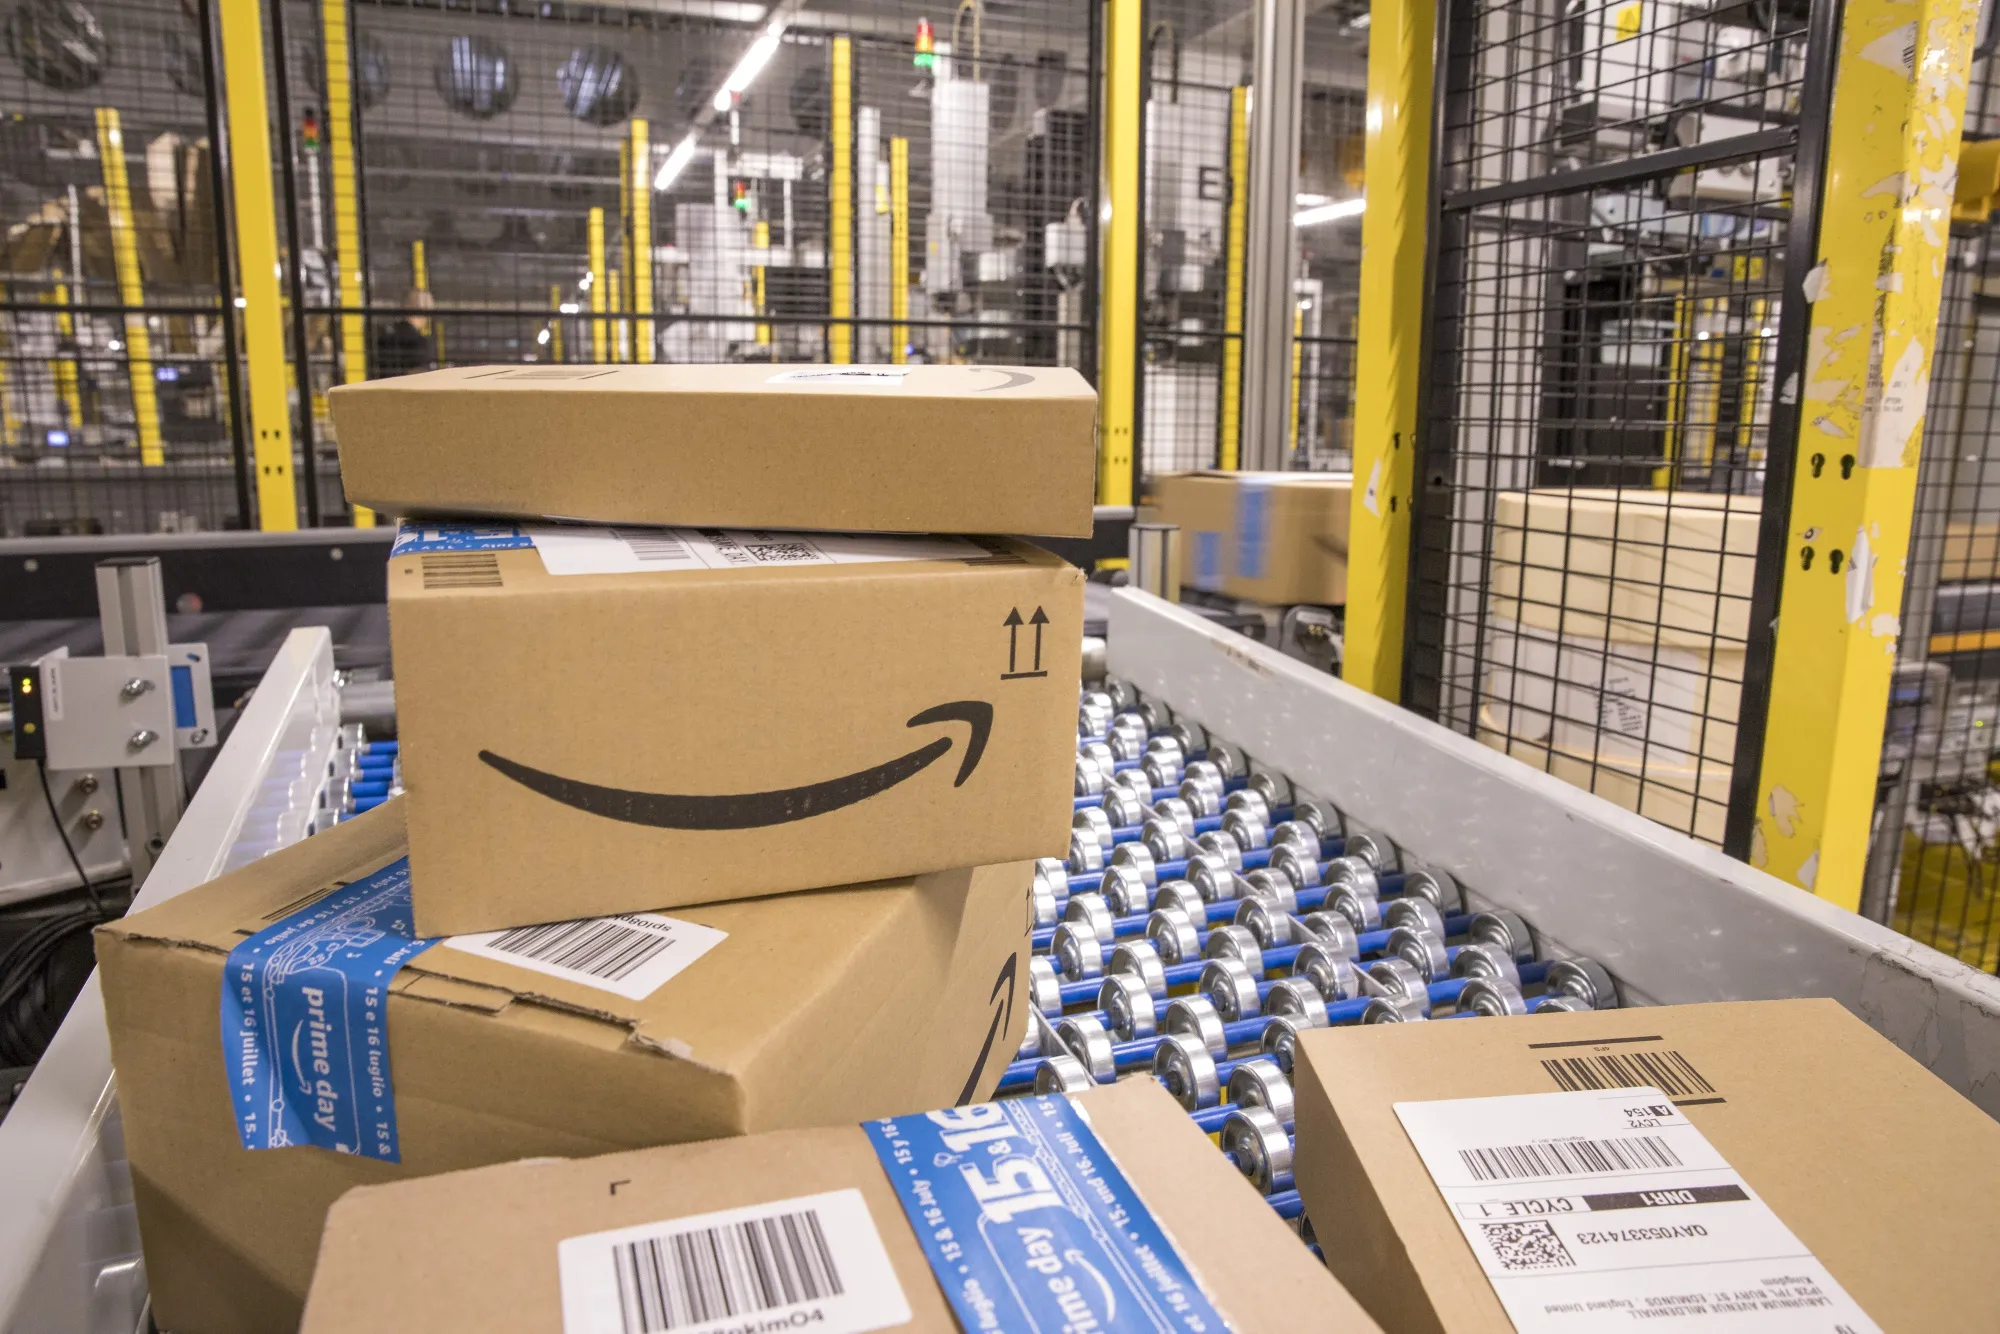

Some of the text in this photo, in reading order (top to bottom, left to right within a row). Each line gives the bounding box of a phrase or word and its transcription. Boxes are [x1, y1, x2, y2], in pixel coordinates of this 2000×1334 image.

[240, 962, 255, 983] 15
[244, 1008, 256, 1028] 16
[365, 987, 386, 1097] 15 e 16 luglio
[239, 1031, 260, 1085] juillet
[301, 986, 339, 1132] prime day
[1624, 1106, 1653, 1118] 154
[375, 1121, 391, 1140] 15
[1630, 1119, 1662, 1129] LCY2
[1055, 1131, 1083, 1155] Juli
[893, 1148, 914, 1165] 15
[924, 1101, 1066, 1224] 15 & 16
[911, 1179, 937, 1207] July
[1086, 1176, 1117, 1205] und
[1640, 1189, 1697, 1207] DNR1
[923, 1207, 946, 1227] 16
[1479, 1197, 1573, 1217] CYCLE 1
[1577, 1224, 1708, 1245] QAY053374123
[941, 1241, 963, 1262] 15
[1134, 1243, 1184, 1293] juillet
[1016, 1226, 1106, 1334] ime day
[1165, 1291, 1192, 1313] 16
[1545, 1302, 1586, 1314] United
[1590, 1299, 1634, 1312] England
